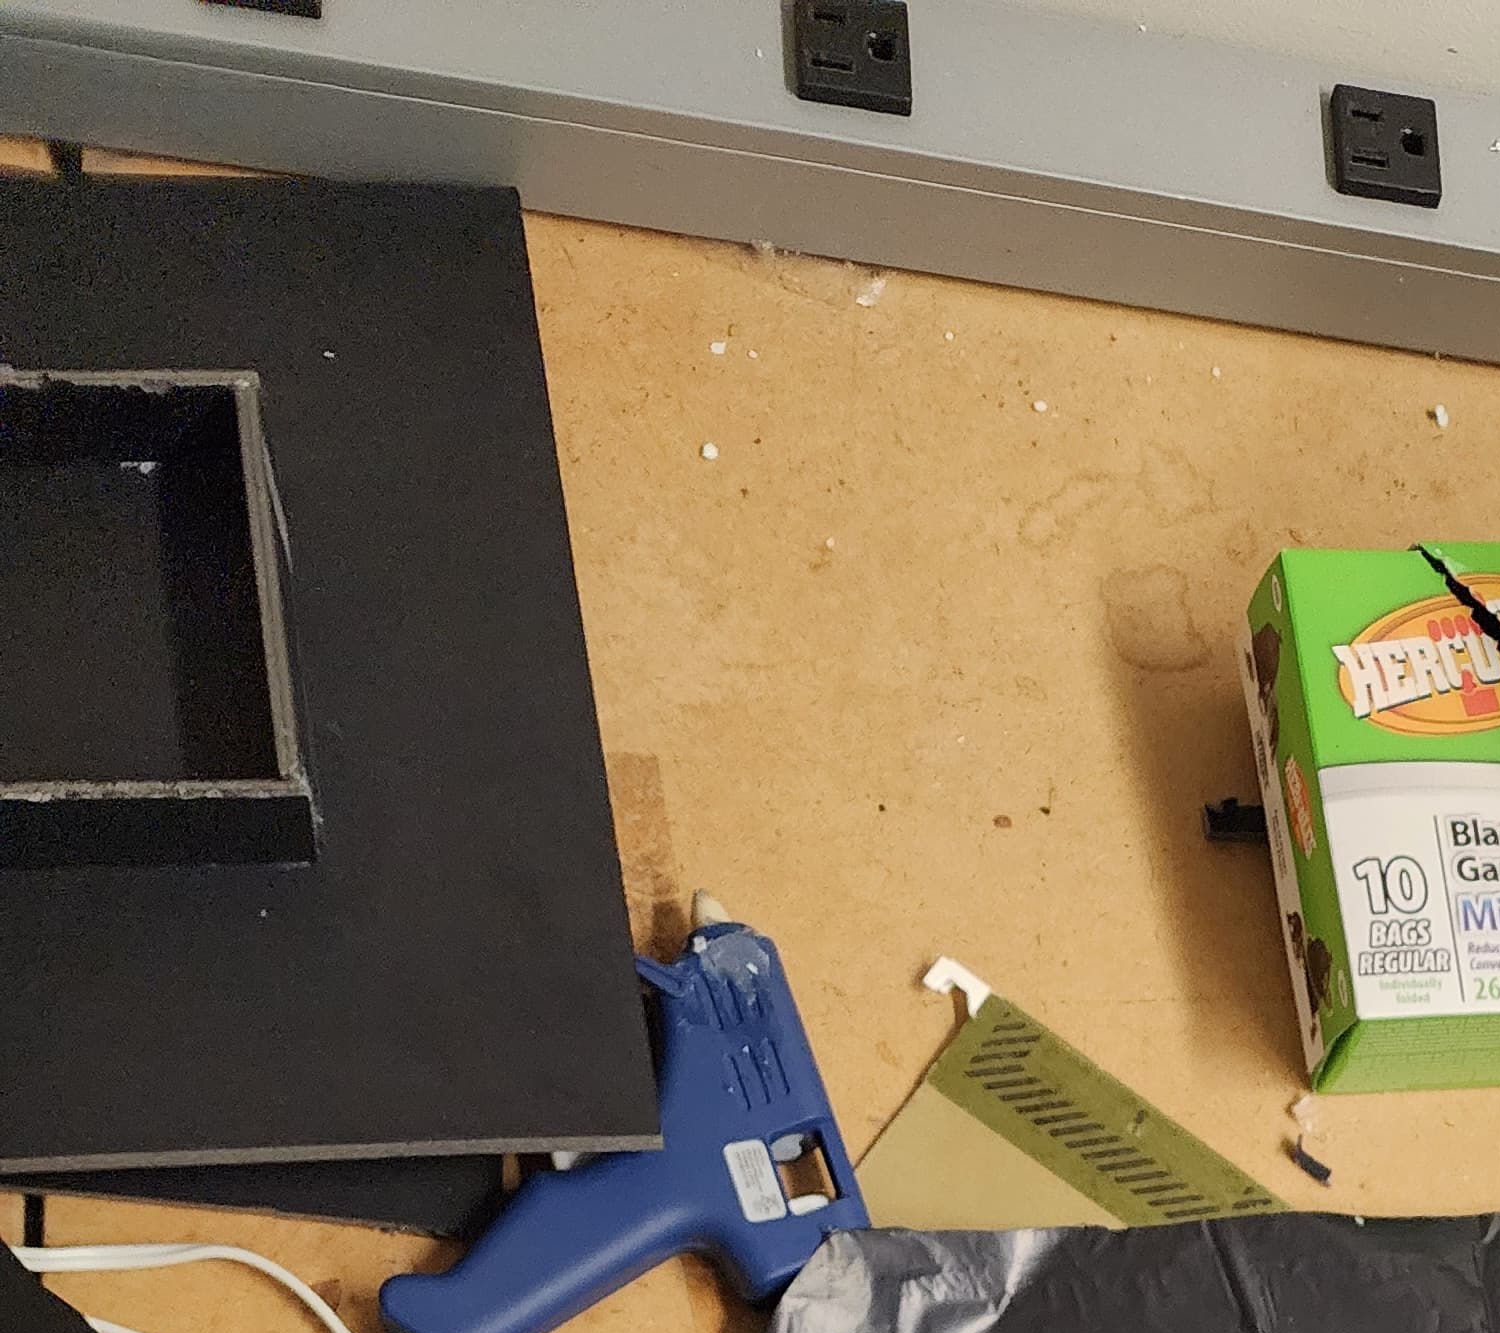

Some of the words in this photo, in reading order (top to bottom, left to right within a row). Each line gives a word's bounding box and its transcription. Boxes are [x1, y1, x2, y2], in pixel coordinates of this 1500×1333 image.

[1353, 855, 1428, 914] 10
[1370, 918, 1431, 948] BAGS
[1359, 949, 1451, 976] REGULAR
